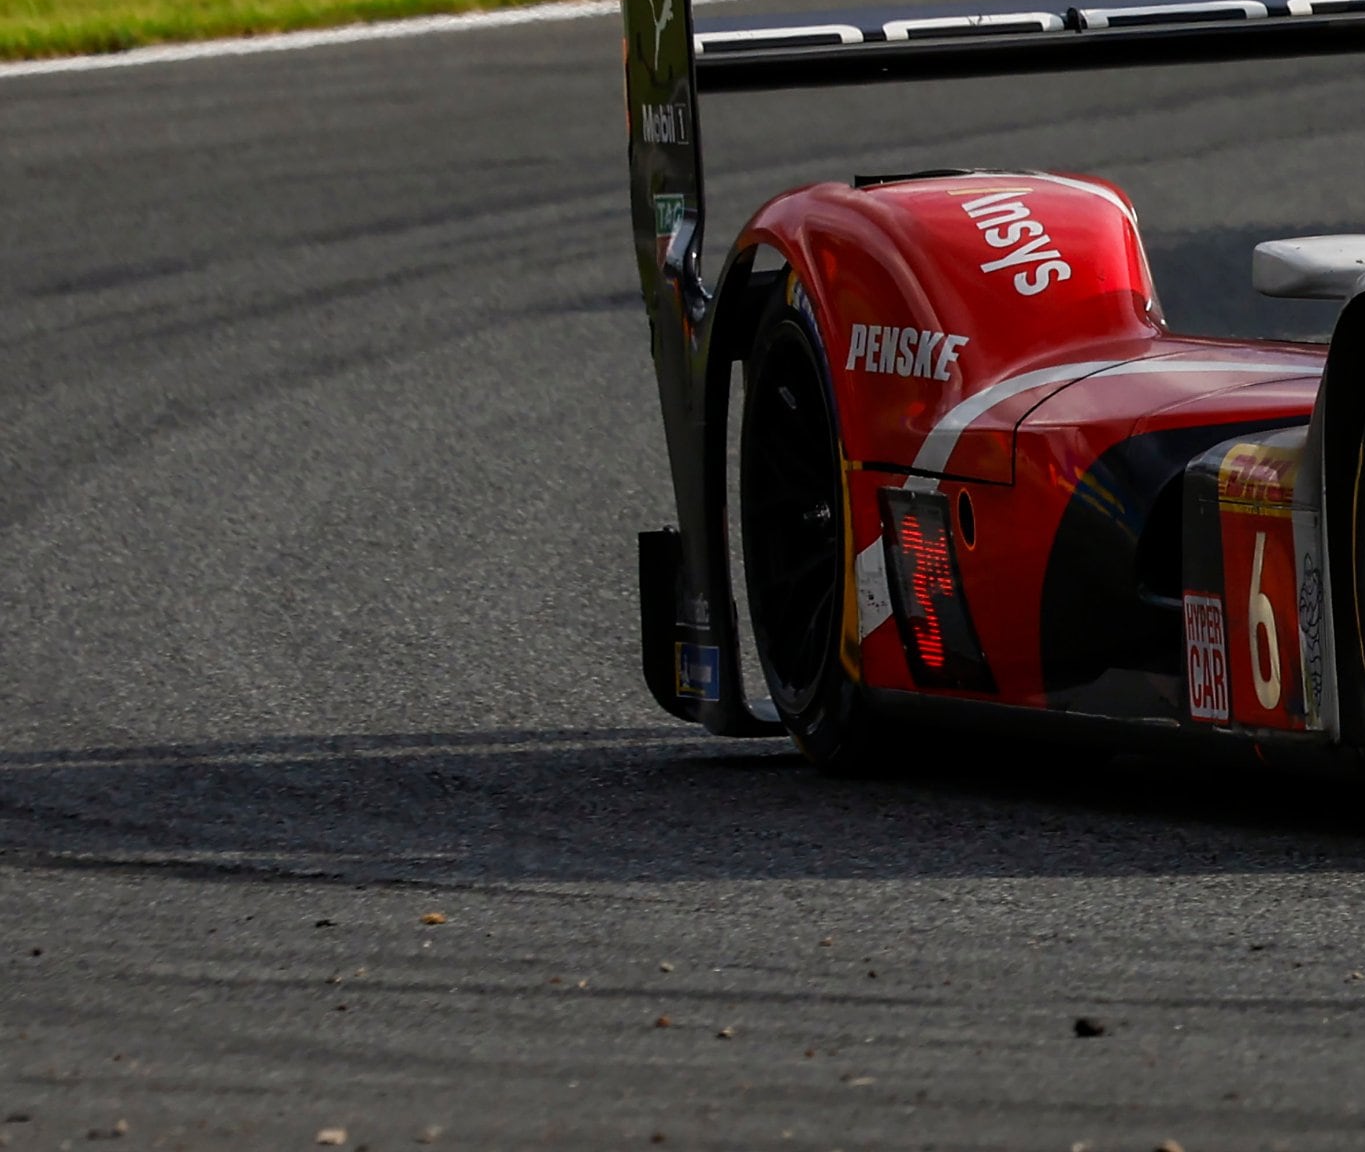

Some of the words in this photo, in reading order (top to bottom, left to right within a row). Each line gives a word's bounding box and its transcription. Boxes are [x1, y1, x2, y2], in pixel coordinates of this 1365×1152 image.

[642, 104, 676, 144] Mobil
[947, 188, 1072, 296] Ansys
[846, 323, 970, 383] PENSKE
[1184, 602, 1222, 645] HYPER
[1249, 532, 1281, 710] 6
[1189, 644, 1227, 711] CAR
